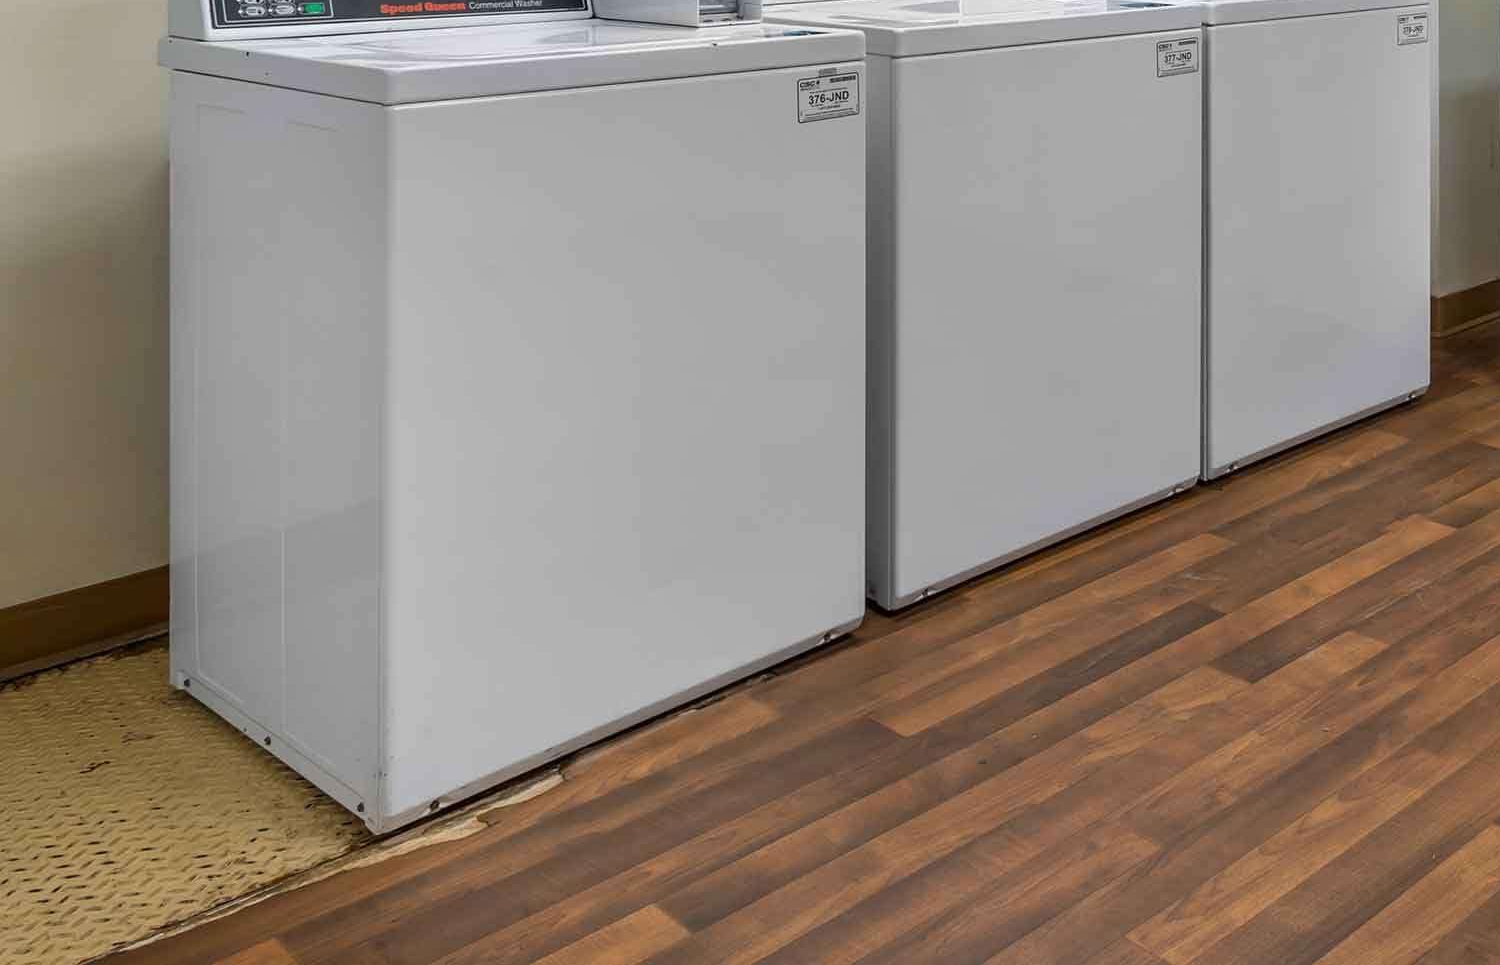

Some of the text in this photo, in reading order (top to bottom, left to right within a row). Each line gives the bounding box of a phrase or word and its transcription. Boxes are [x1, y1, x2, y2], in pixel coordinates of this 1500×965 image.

[380, 0, 543, 15] Speed Queen Commercial Washer
[808, 91, 849, 105] 376-JND
